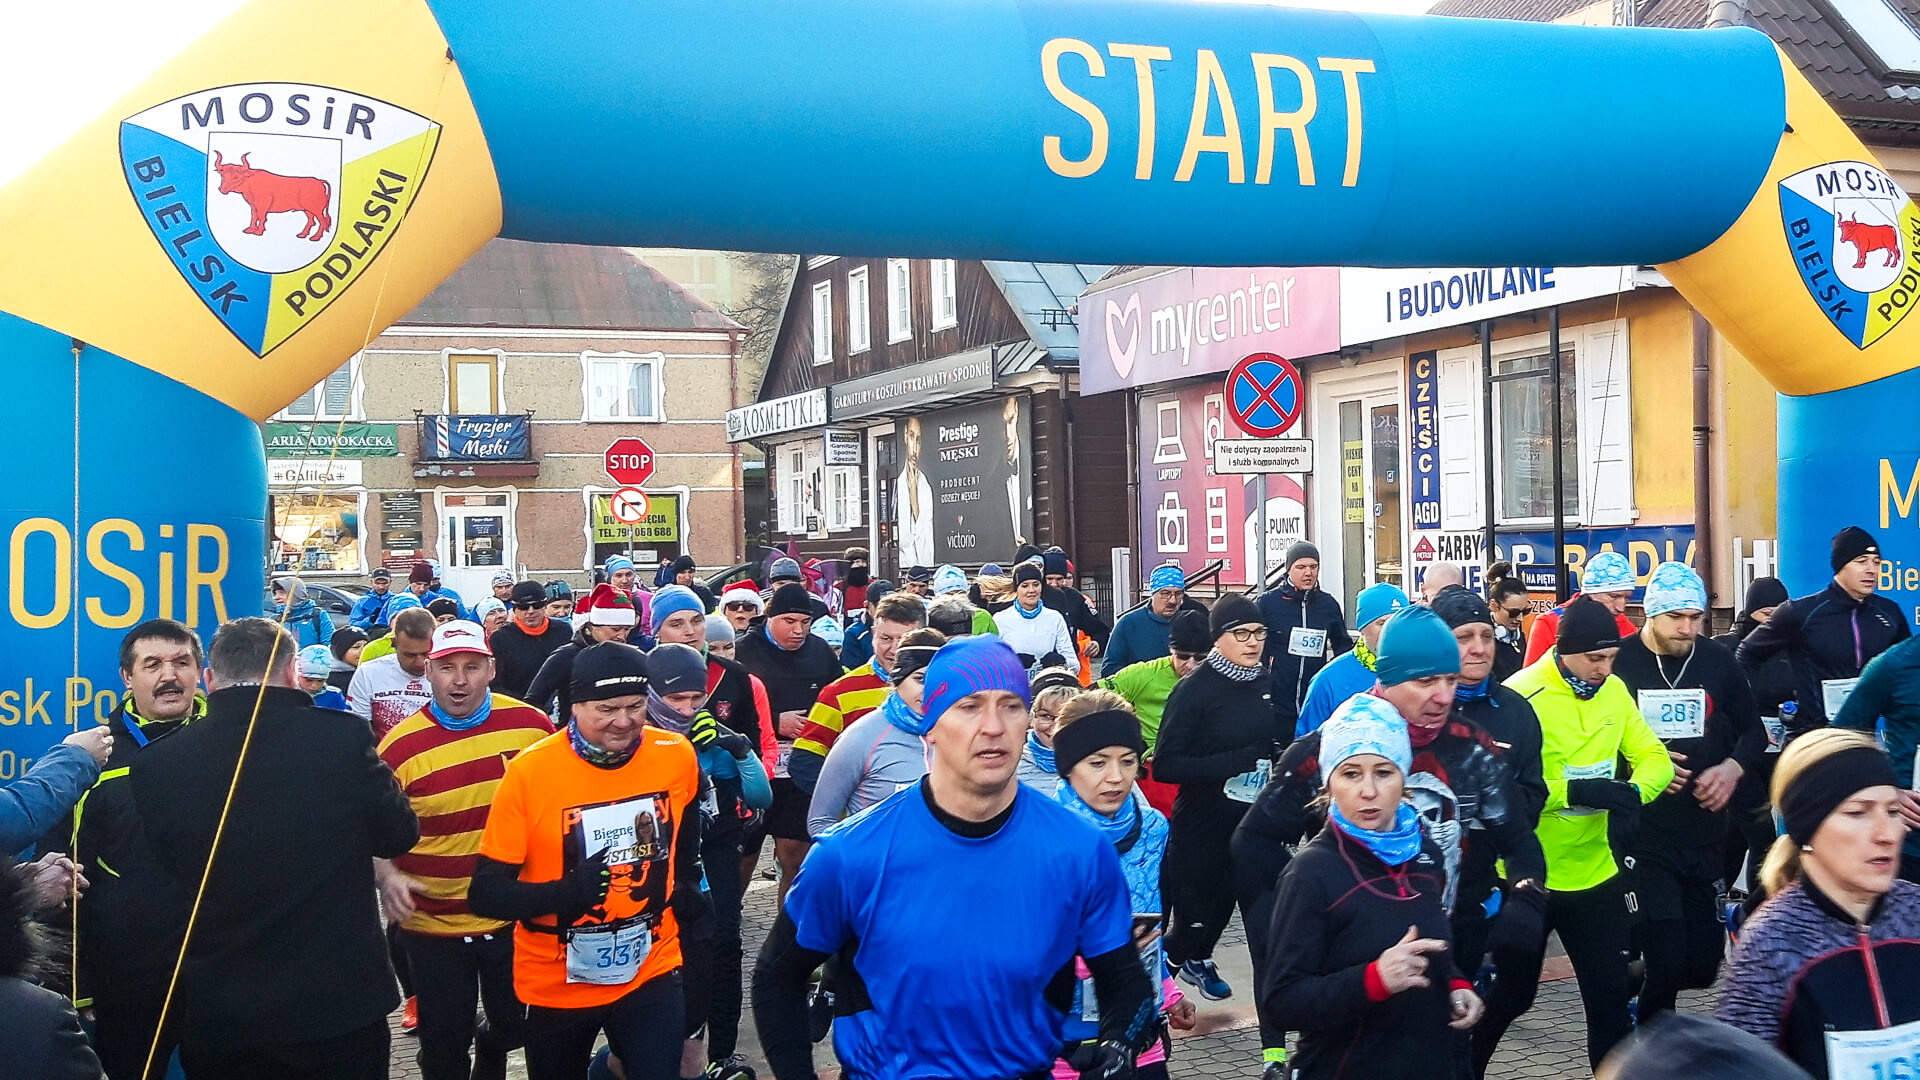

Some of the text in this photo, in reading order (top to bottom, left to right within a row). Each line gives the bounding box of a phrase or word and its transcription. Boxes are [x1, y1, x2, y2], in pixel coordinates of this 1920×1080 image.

[181, 93, 376, 140] MOSiR
[1040, 37, 1377, 187] START
[1815, 168, 1900, 199] MOSiR
[133, 155, 249, 315] BIELSK
[285, 169, 408, 316] PODLASKI
[1790, 217, 1853, 321] BIELSK
[1386, 266, 1556, 323] I BUDOWLANE
[1150, 273, 1297, 366] mycenter
[834, 360, 990, 409] GARNITURY KOSZULE KRAWATY SPODNIE
[743, 395, 813, 436] KOSMETYKI
[457, 418, 512, 438] Fryzjer
[939, 421, 979, 443] Prestige
[1415, 358, 1434, 497] CZĘŚCI
[266, 435, 394, 447] ARIA ADWOKACKA
[461, 438, 510, 458] Męski
[1220, 445, 1307, 456] Nie dotyczy zaopatrzenia
[609, 454, 651, 470] STOP
[940, 445, 979, 462] MĘSKI
[1232, 457, 1252, 466] służb
[1253, 457, 1299, 467] komunalnych
[285, 469, 335, 481] Galilea
[940, 475, 980, 489] PRODUCENT
[1158, 467, 1182, 481] LAPTOPY
[1414, 501, 1439, 524] AGD
[616, 528, 631, 538] 79
[1269, 517, 1300, 535] PUNKT
[1438, 534, 1481, 561] FARBY
[1536, 573, 1556, 587] PIĘTR
[1661, 703, 1686, 722] 28
[593, 825, 634, 841] Biegnę
[603, 839, 619, 848] dla
[596, 944, 631, 968] 33
